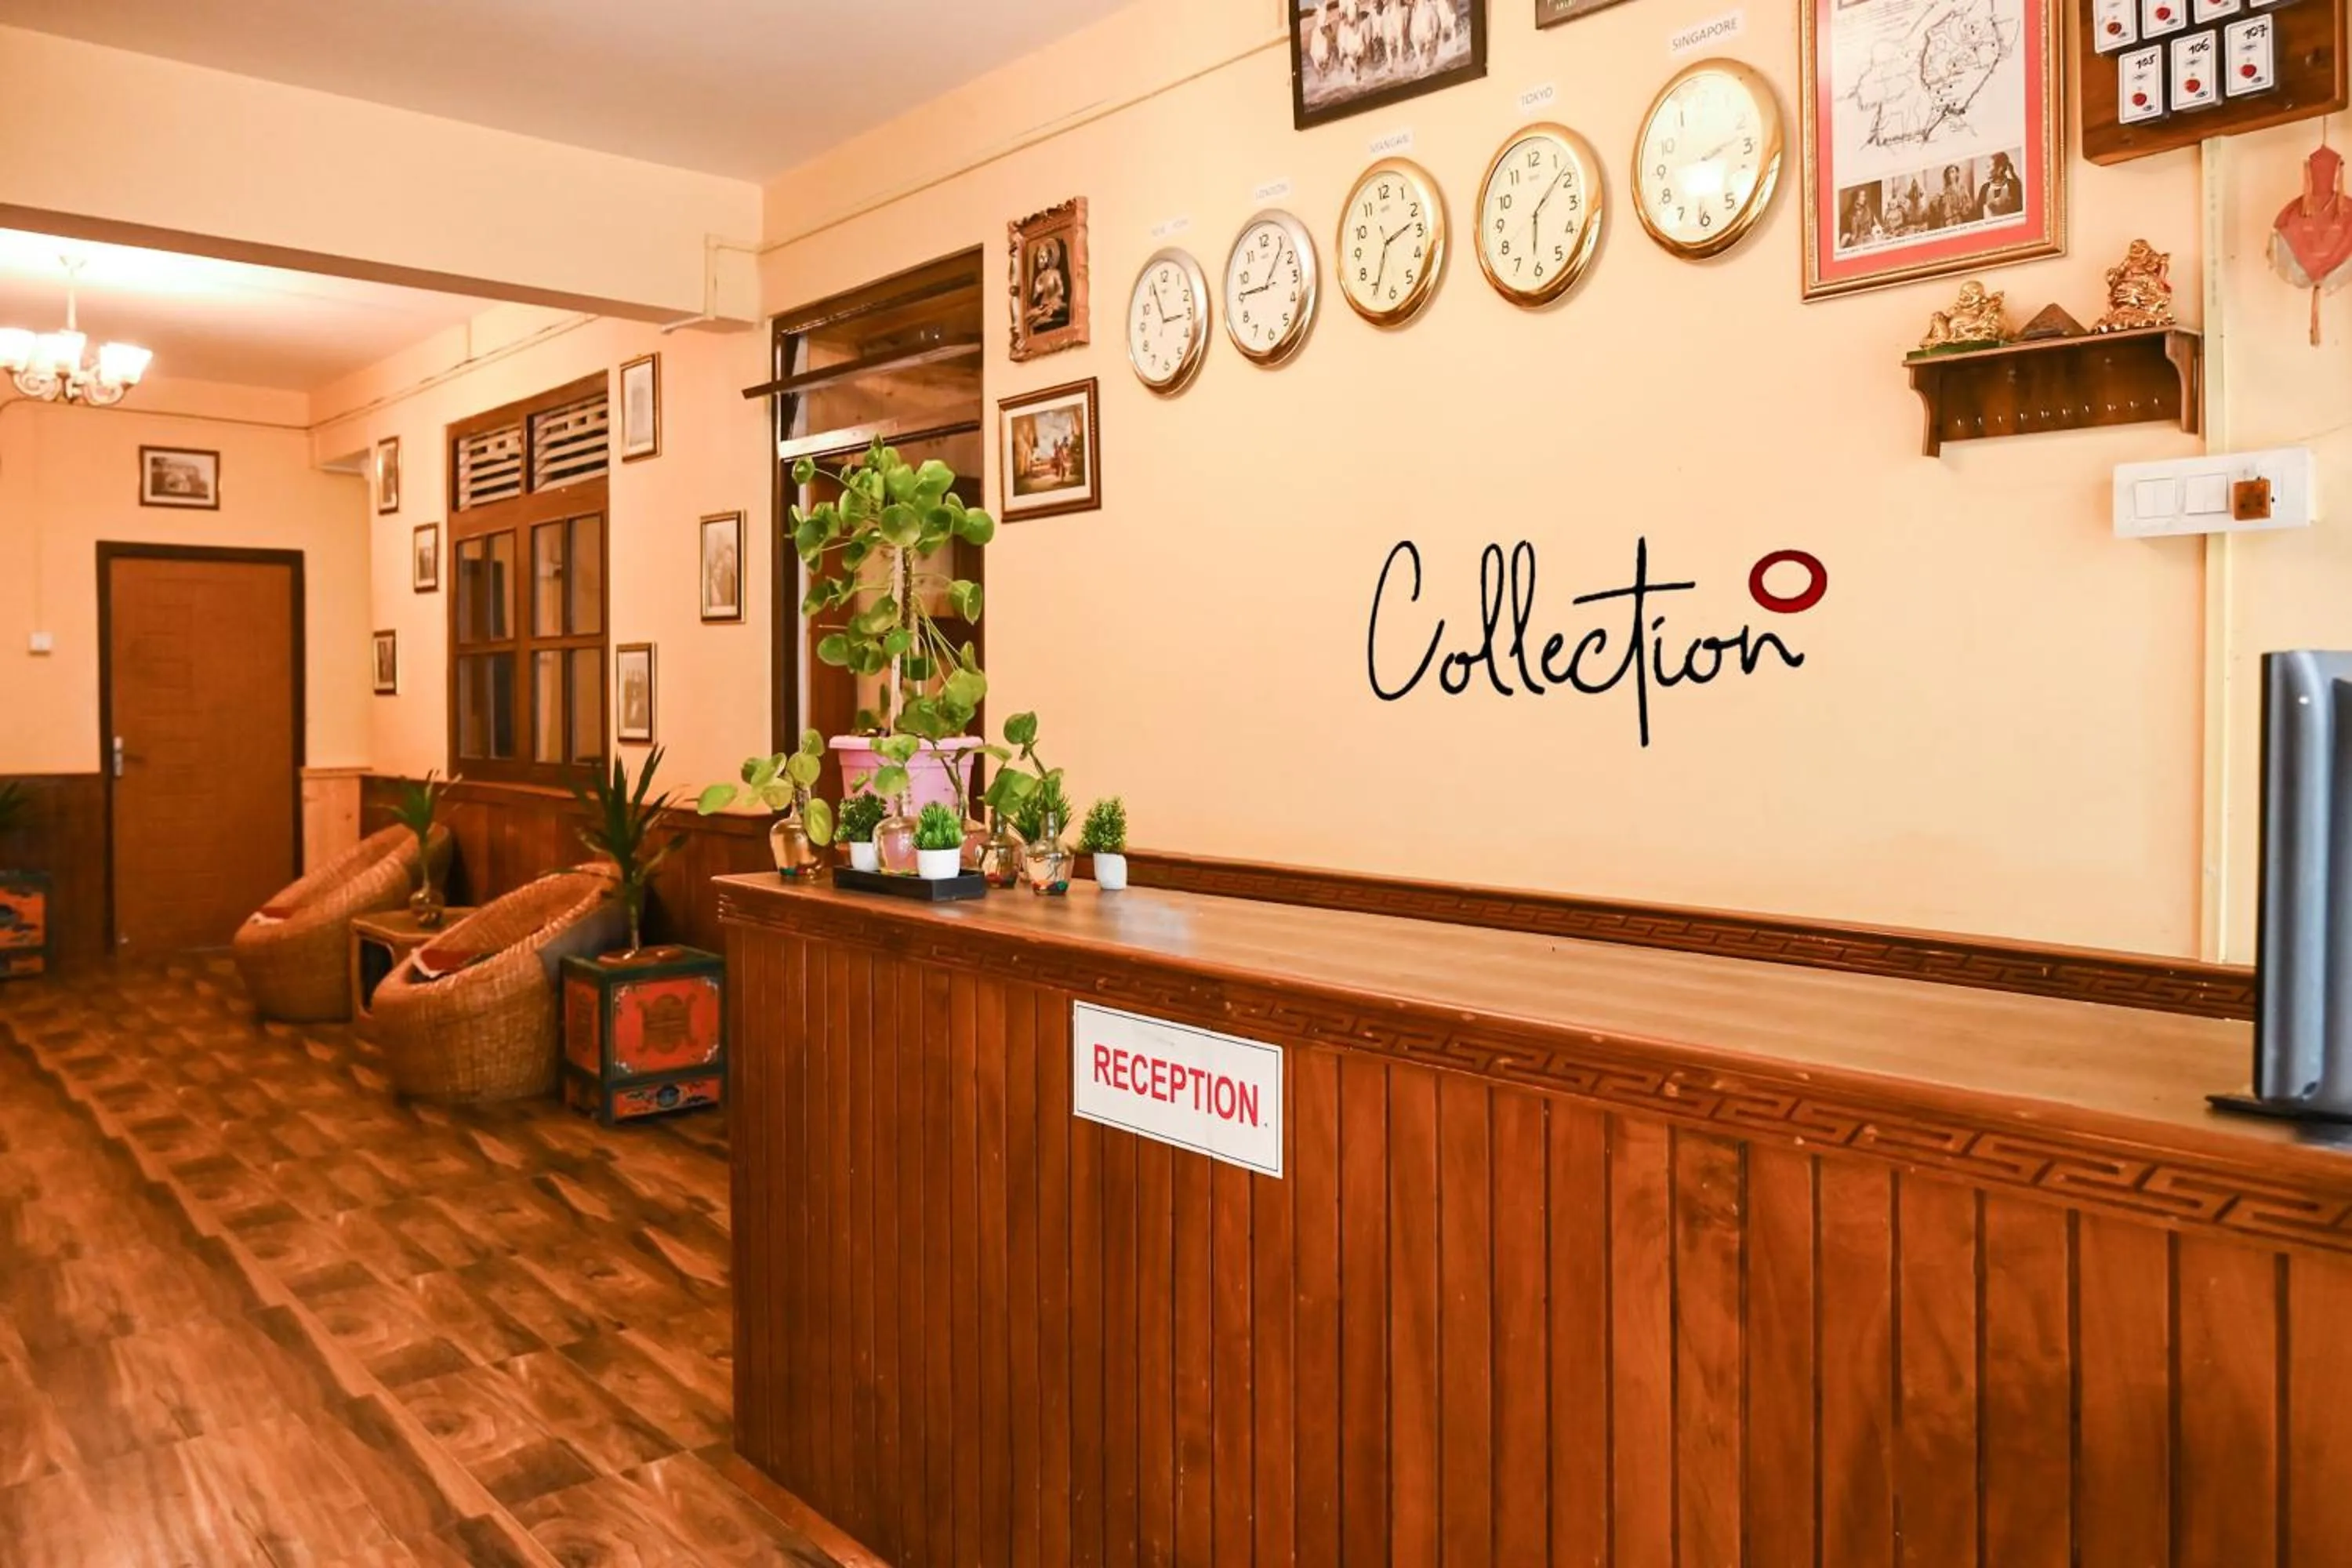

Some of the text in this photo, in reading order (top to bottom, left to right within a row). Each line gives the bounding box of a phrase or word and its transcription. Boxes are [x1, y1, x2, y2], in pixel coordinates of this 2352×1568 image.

[1671, 17, 1738, 51] SINGAPORE
[2243, 24, 2268, 40] 107
[2189, 38, 2211, 55] 106
[2135, 54, 2156, 70] 105
[1521, 87, 1553, 107] TOKYO
[1661, 136, 1675, 156] 10
[1743, 137, 1753, 155] 3
[1527, 151, 1541, 168] 12
[1510, 169, 1519, 186] 11
[1657, 164, 1667, 180] 9
[1563, 172, 1572, 188] 2
[1377, 184, 1390, 200] 12
[1661, 188, 1671, 204] 8
[1499, 194, 1512, 211] 10
[1569, 195, 1578, 211] 3
[1725, 193, 1734, 210] 5
[1363, 202, 1373, 217] 11
[1410, 203, 1418, 217] 2
[1677, 206, 1685, 221] 7
[1496, 219, 1504, 234] 9
[1565, 220, 1574, 234] 4
[1700, 212, 1711, 227] 6
[1356, 225, 1367, 241] 10
[1416, 223, 1424, 238] 3
[1259, 233, 1269, 248] 12
[1501, 240, 1510, 255] 8
[1247, 250, 1254, 264] 11
[1287, 251, 1294, 264] 2
[1354, 248, 1362, 261] 9
[1414, 245, 1421, 259] 4
[1555, 245, 1563, 261] 5
[1514, 257, 1522, 272] 7
[1534, 262, 1543, 277] 6
[1160, 270, 1169, 283] 12
[1239, 270, 1249, 285] 10
[1292, 270, 1298, 283] 3
[1359, 267, 1367, 281] 8
[1406, 270, 1414, 285] 5
[1182, 289, 1189, 302] 2
[1290, 291, 1296, 302] 4
[1370, 283, 1378, 296] 7
[1388, 285, 1396, 299] 6
[1142, 303, 1150, 316] 10
[1186, 307, 1192, 321] 3
[1243, 311, 1250, 324] 8
[1282, 313, 1289, 327] 5
[1139, 321, 1146, 332] 9
[1183, 327, 1189, 339] 4
[1252, 325, 1258, 337] 7
[1269, 328, 1275, 341] 6
[1142, 340, 1149, 352] 8
[1177, 347, 1182, 360] 5
[1151, 354, 1156, 366] 7
[1163, 358, 1170, 371] 6
[1368, 536, 1804, 747] Collection
[1094, 1044, 1258, 1127] RECEPTION
